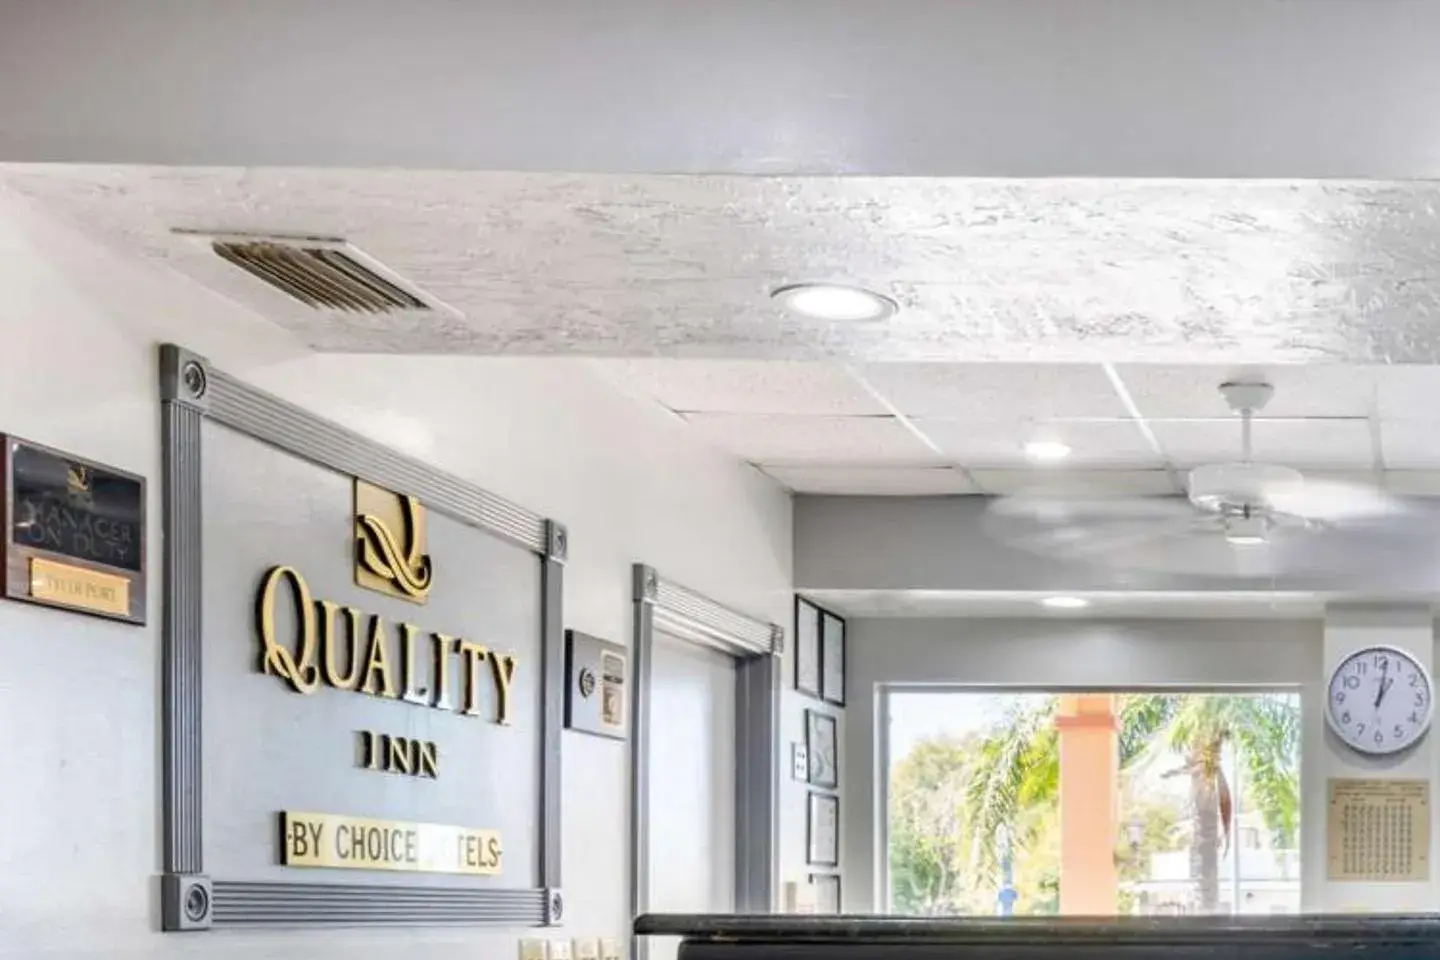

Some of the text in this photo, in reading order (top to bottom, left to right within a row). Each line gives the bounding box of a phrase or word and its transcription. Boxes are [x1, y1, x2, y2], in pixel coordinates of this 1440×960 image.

[29, 521, 128, 561] ON DUTY
[257, 566, 518, 725] QUALITY
[1342, 675, 1360, 690] 10
[361, 731, 439, 779] INN
[335, 824, 418, 863] CHOICE
